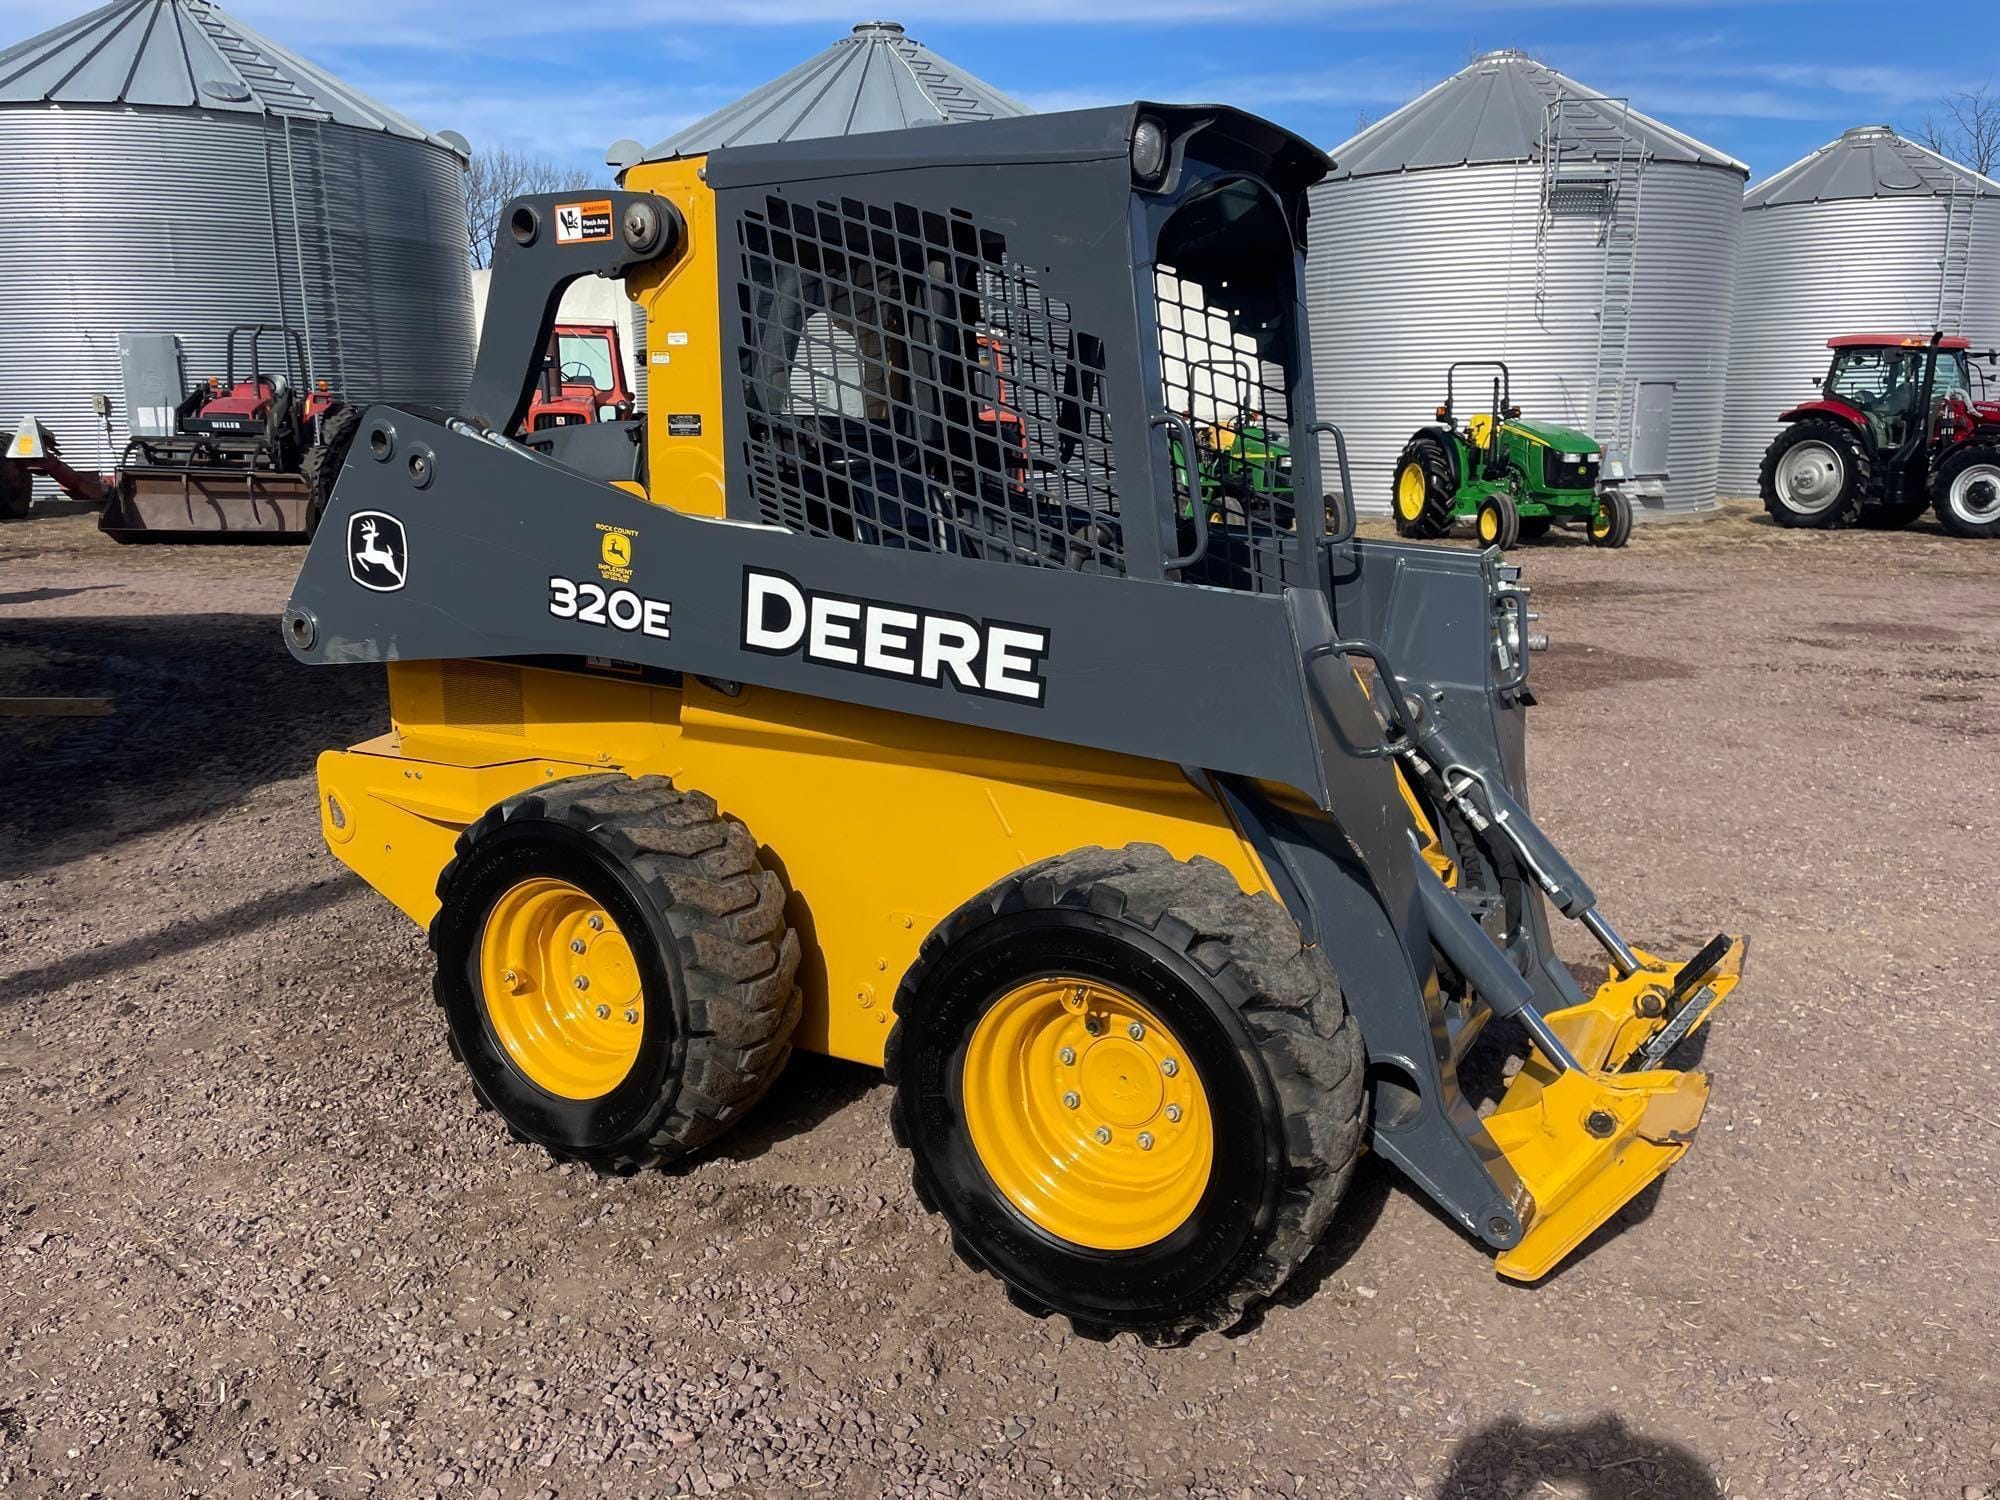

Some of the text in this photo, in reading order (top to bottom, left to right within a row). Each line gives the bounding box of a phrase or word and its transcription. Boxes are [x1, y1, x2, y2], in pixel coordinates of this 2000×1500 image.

[595, 523, 639, 537] ROCK COUNTY
[598, 563, 634, 576] IMPLEMENT
[549, 577, 671, 639] 320E
[745, 572, 1045, 700] DEERE
